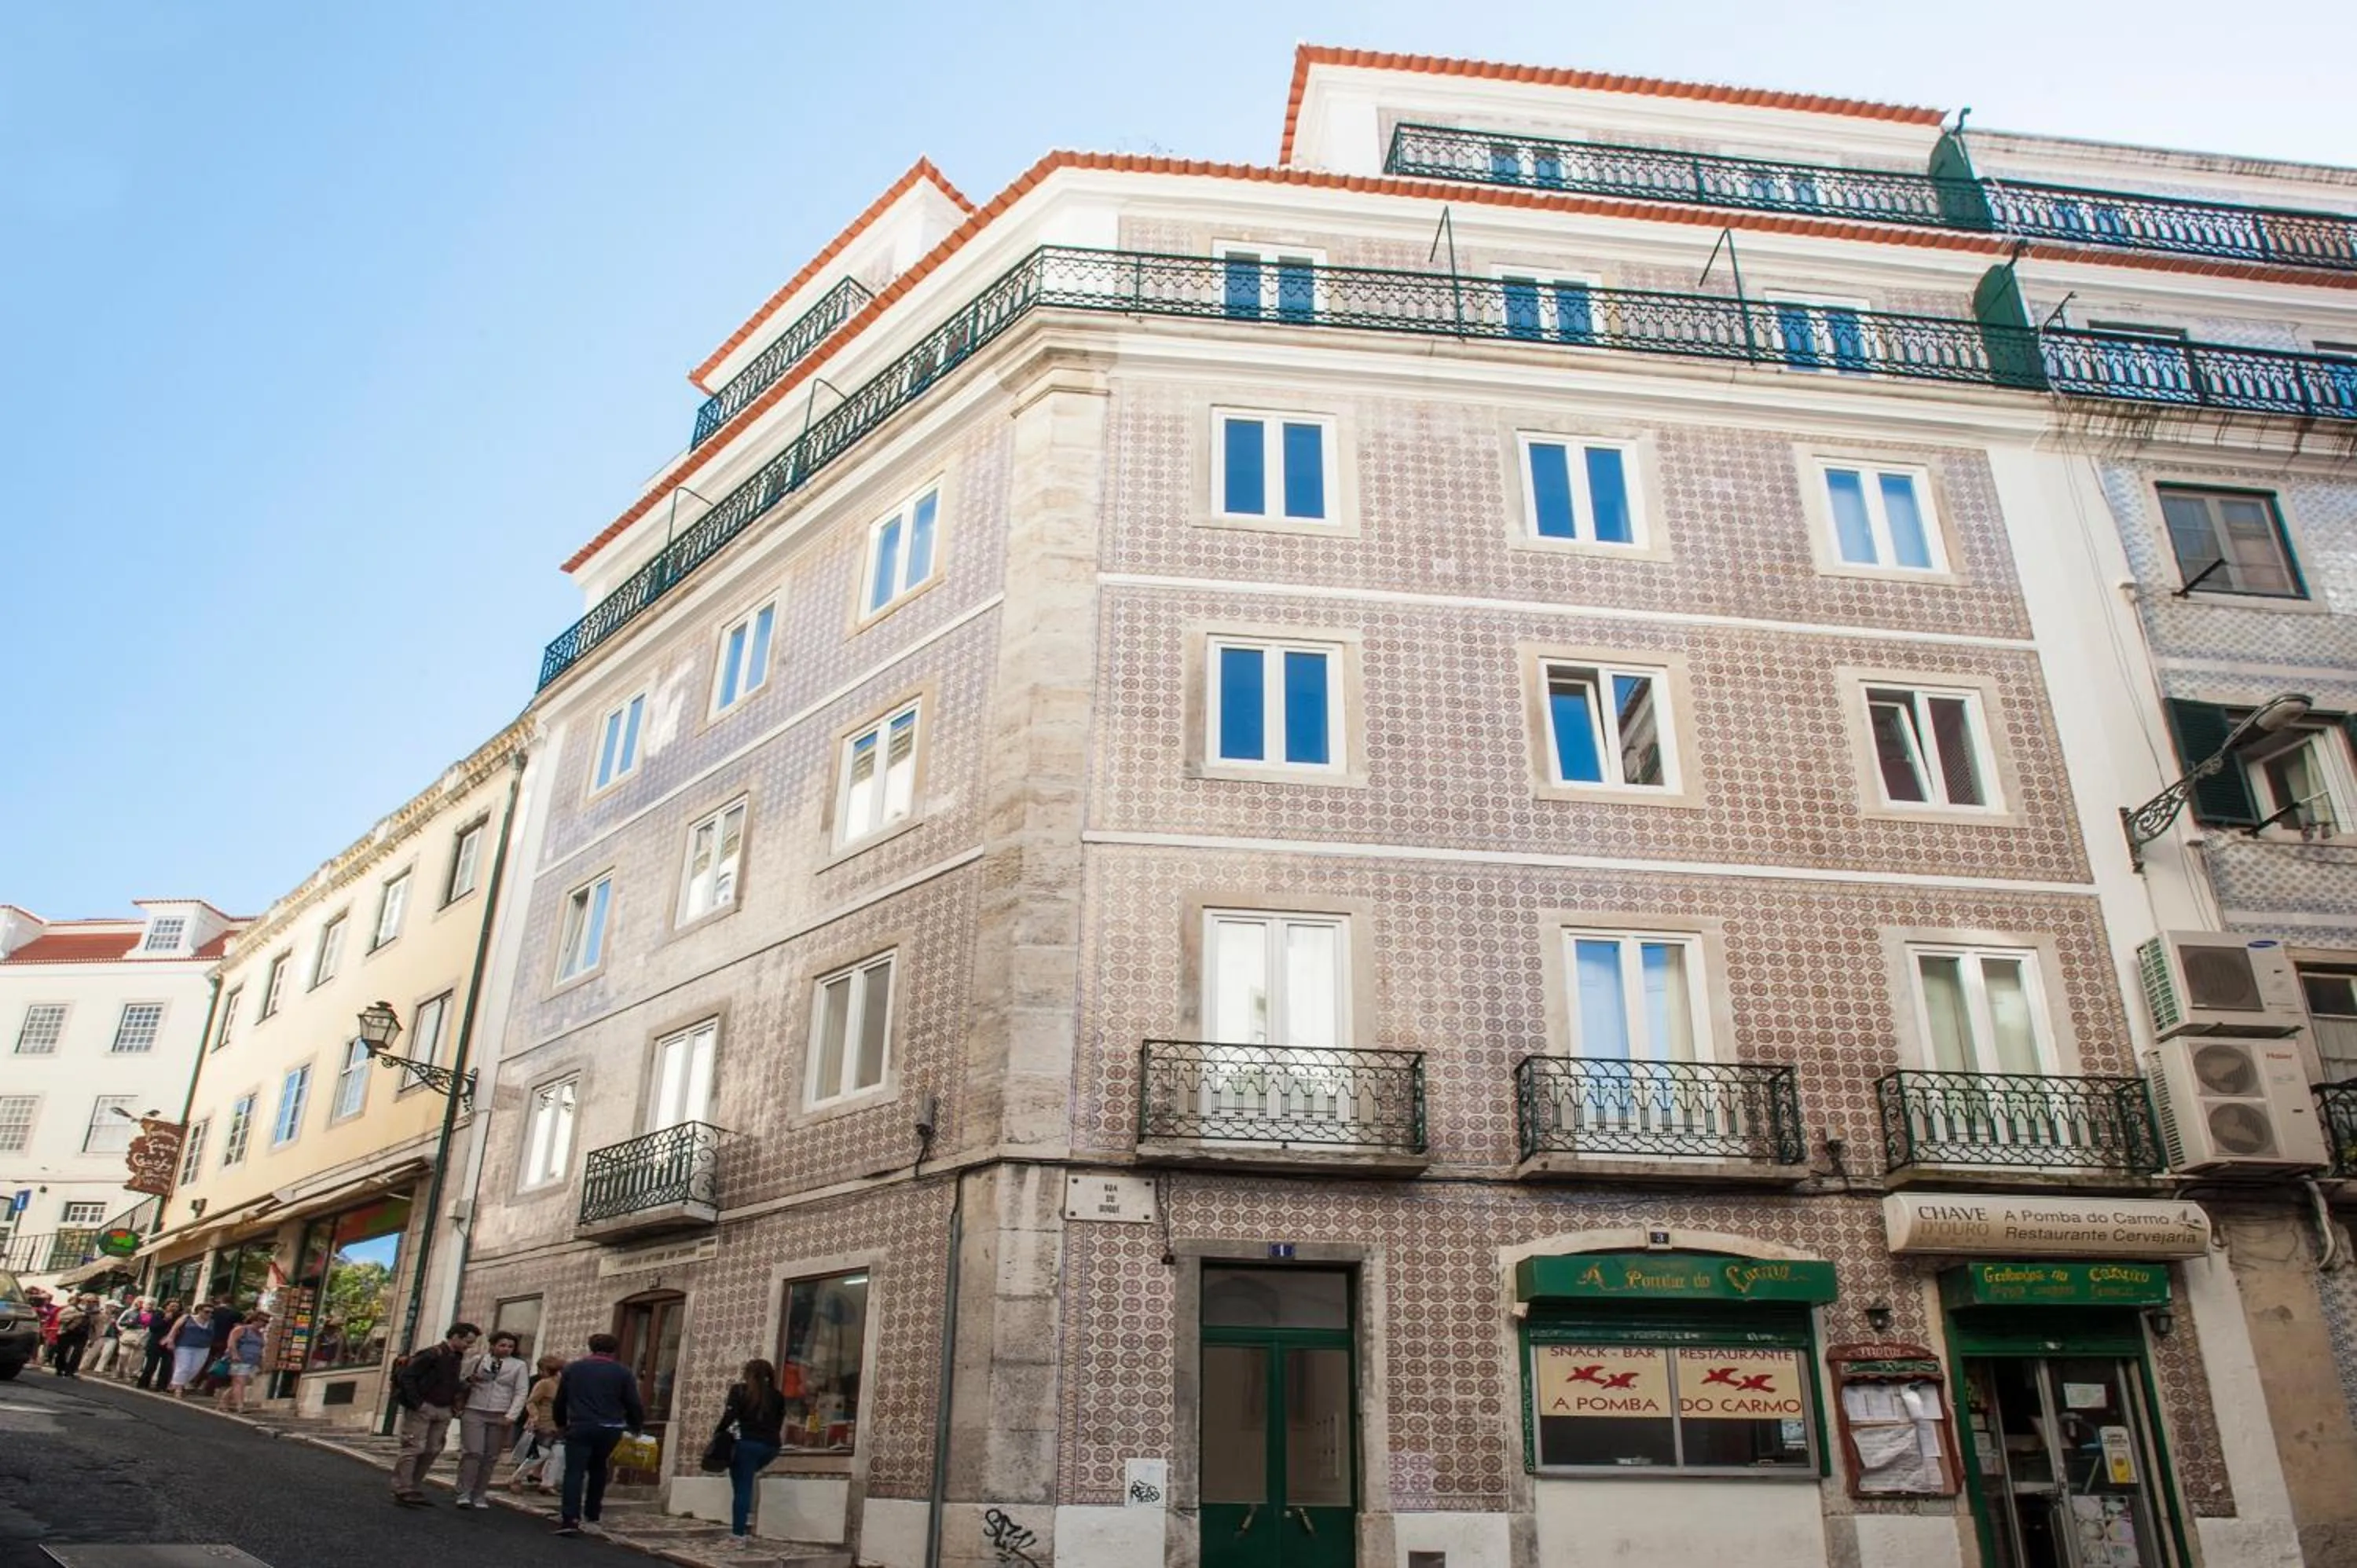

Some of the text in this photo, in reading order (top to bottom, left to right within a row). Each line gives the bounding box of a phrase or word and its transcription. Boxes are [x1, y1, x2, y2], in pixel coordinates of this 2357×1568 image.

[1918, 1206, 1989, 1222] CHAVE
[2004, 1210, 2170, 1225] A Pomba do Carmo
[1919, 1222, 1989, 1236] D'OURO
[2005, 1226, 2197, 1244] Restaurante Cervejaria
[1550, 1346, 1607, 1357] SNACK
[1622, 1348, 1657, 1358] BAR
[1680, 1348, 1793, 1361] RESTAURANTE
[1552, 1397, 1660, 1412] A POMBA
[1680, 1398, 1802, 1414] DO CARMO
